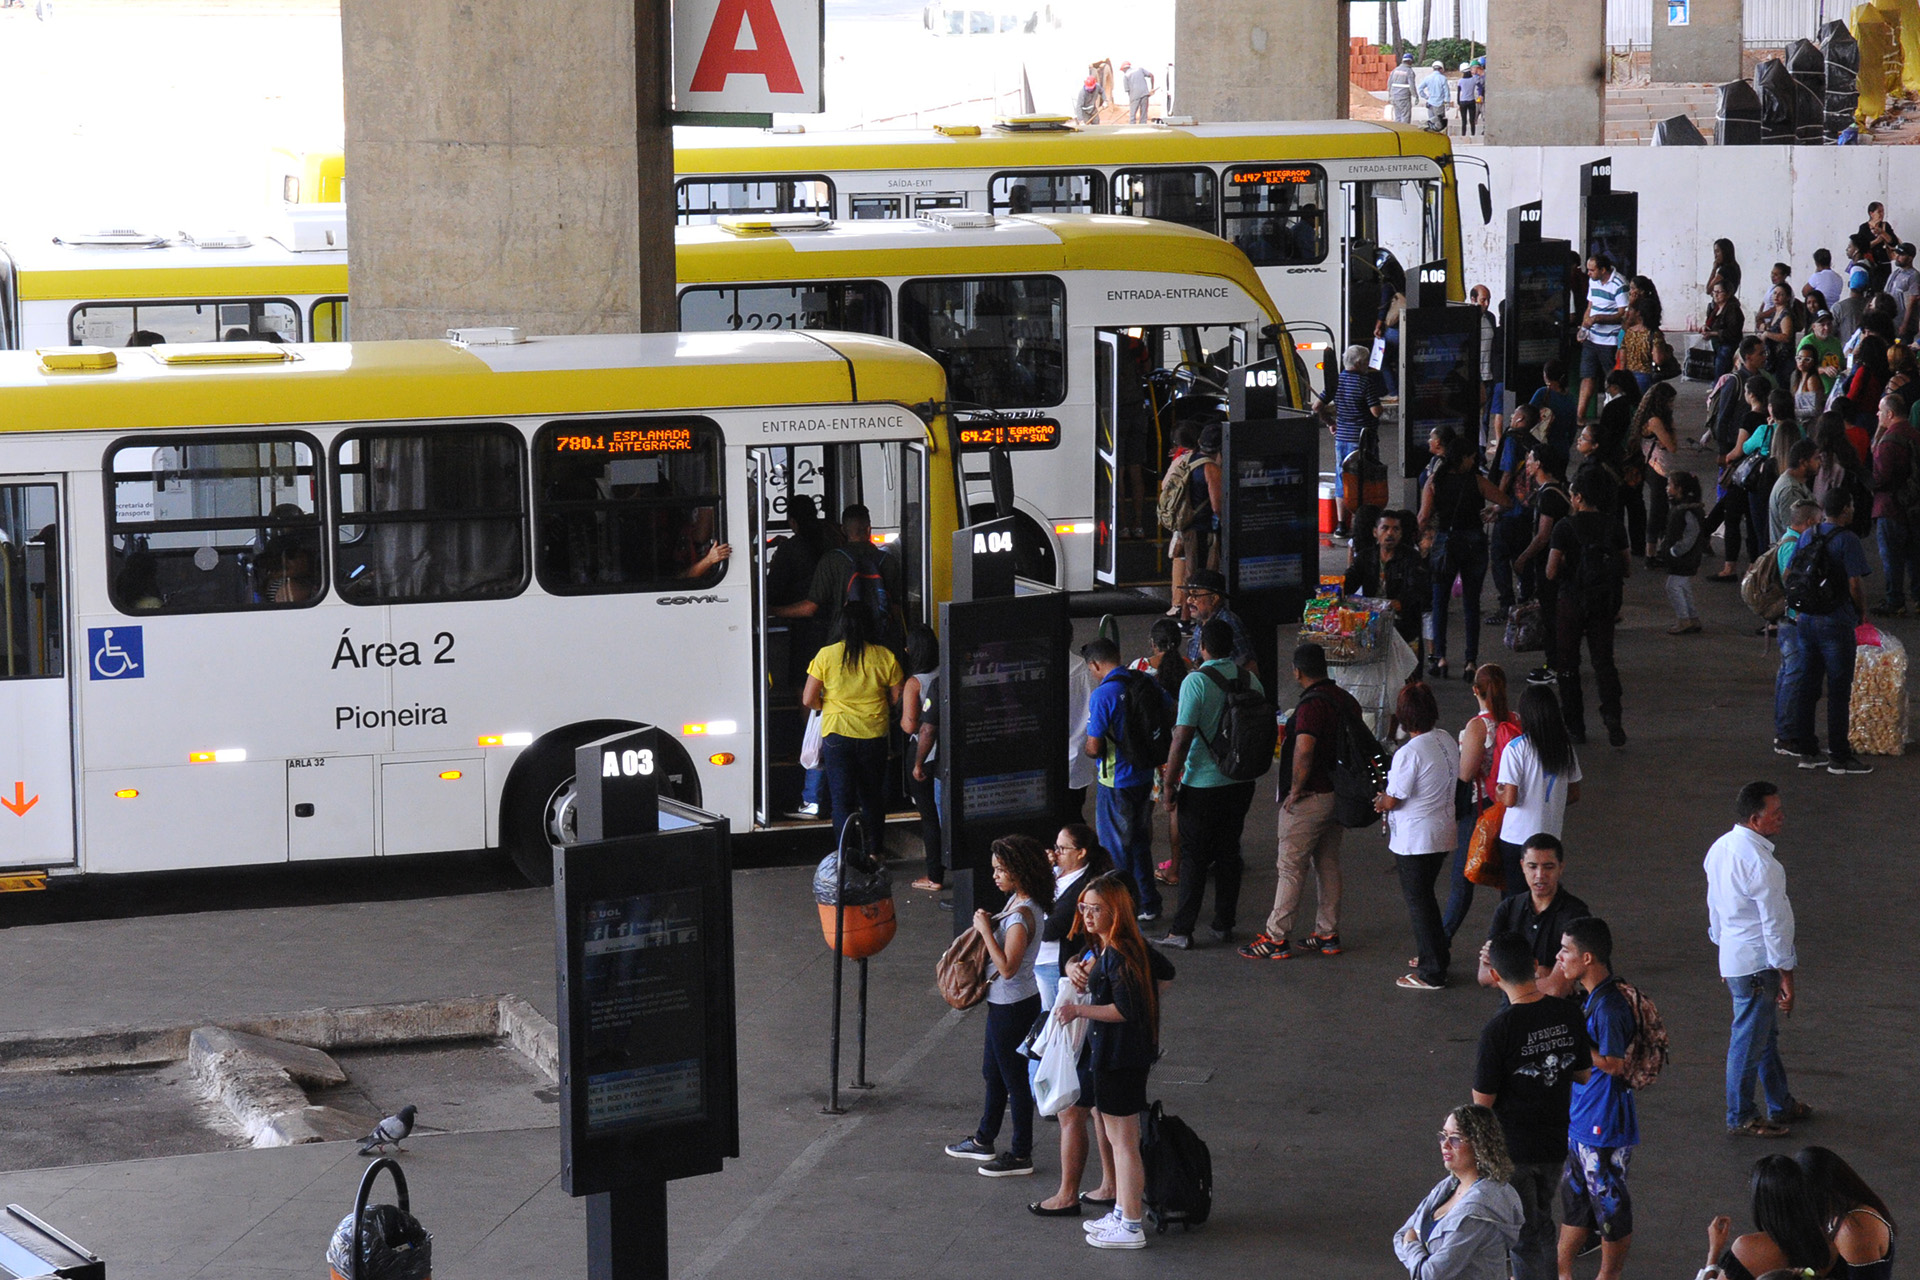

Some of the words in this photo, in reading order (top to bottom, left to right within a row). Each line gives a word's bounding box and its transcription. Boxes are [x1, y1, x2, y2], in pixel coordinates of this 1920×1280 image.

[689, 0, 805, 94] A
[1348, 163, 1429, 173] ENTRADA-ENTRANCE
[1592, 166, 1599, 177] A
[1599, 165, 1612, 176] 08
[888, 179, 934, 188] SAÍDA-EXIT
[1233, 173, 1262, 183] 0.147
[1520, 210, 1528, 222] A
[1528, 209, 1541, 221] 07
[1420, 269, 1429, 283] A
[1429, 269, 1446, 283] 06
[1106, 287, 1229, 301] ENTRADA-ENTRANCE
[1245, 371, 1257, 387] A
[1257, 370, 1278, 387] 05
[762, 415, 904, 433] ENTRADA-ENTRANCE
[556, 435, 605, 452] 780.1
[613, 429, 691, 442] ESPLANADA
[1029, 433, 1050, 443] SUL
[973, 533, 988, 554] A
[988, 531, 1013, 553] 04
[656, 594, 729, 606] COMIL
[331, 627, 422, 670] Área
[433, 631, 456, 665] 2
[335, 702, 448, 730] Pioneira
[288, 759, 313, 769] ARLA
[314, 757, 326, 767] 32
[602, 750, 620, 778] A
[621, 748, 655, 777] 03
[598, 908, 621, 919] UOL
[1526, 1023, 1569, 1046] AVENGED
[1520, 1036, 1575, 1056] SEVENFOLD
